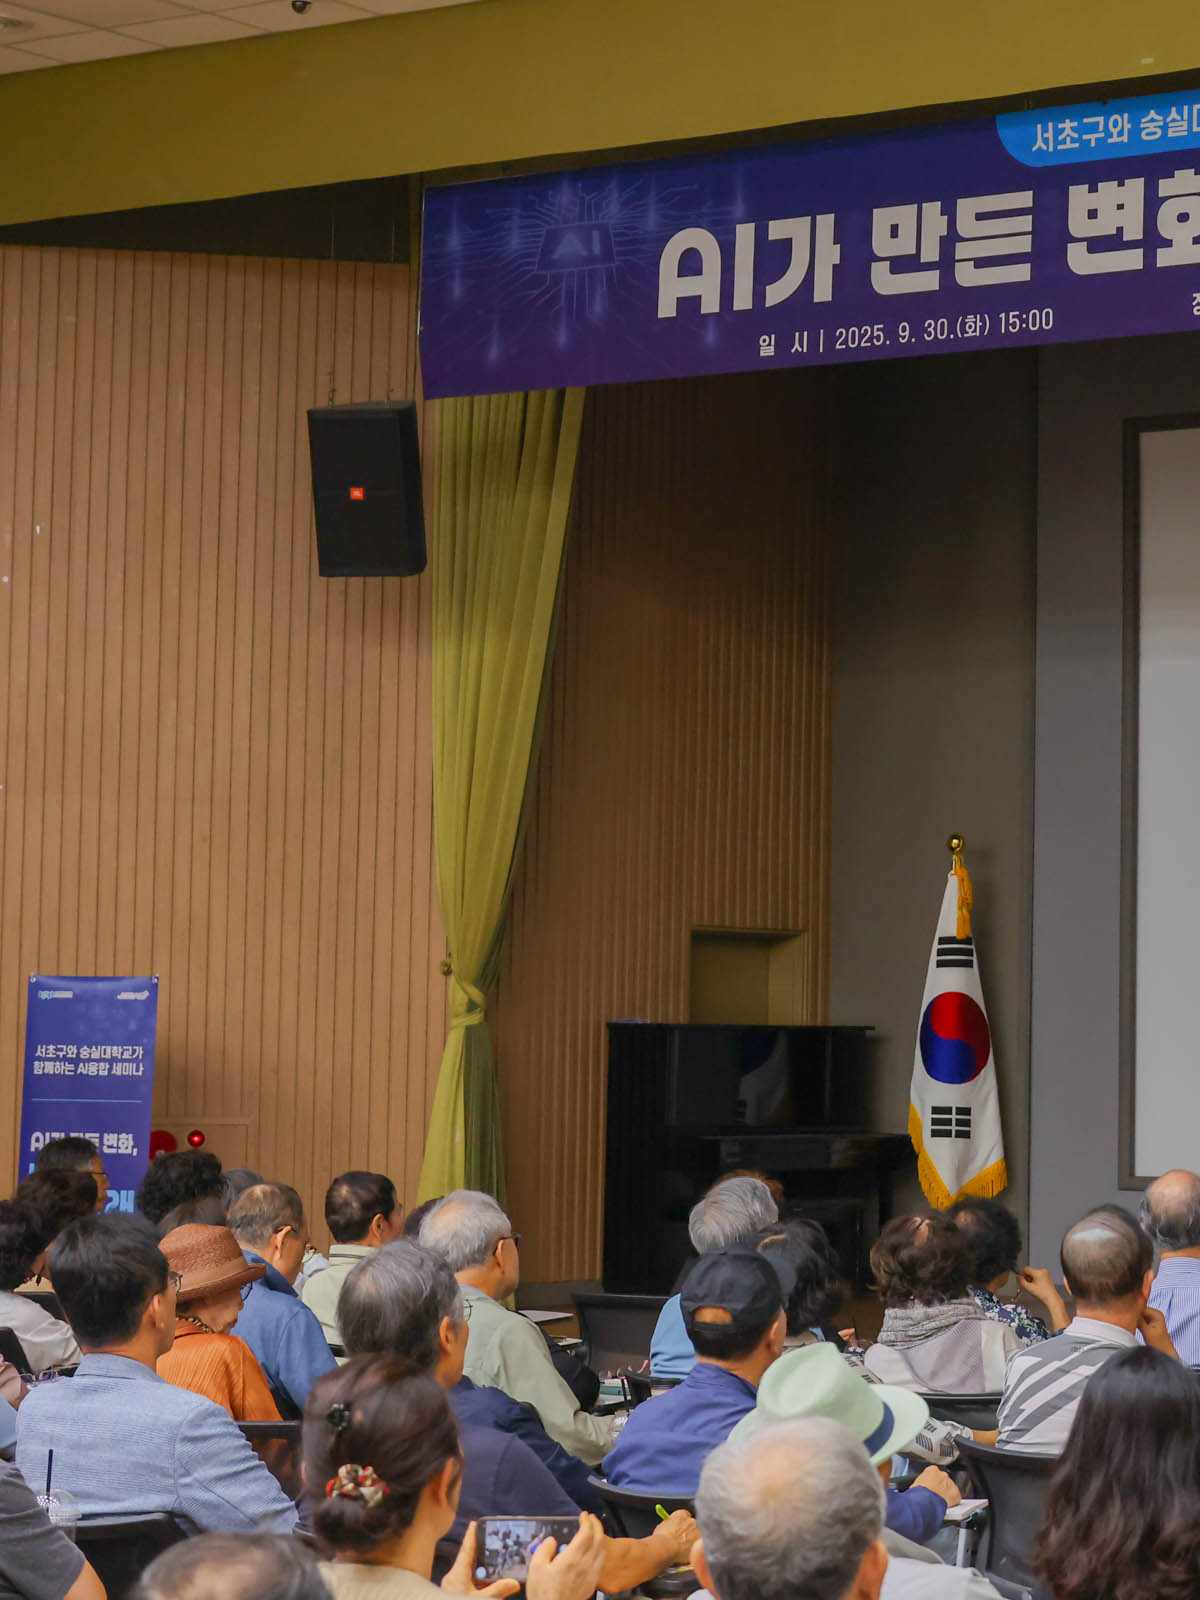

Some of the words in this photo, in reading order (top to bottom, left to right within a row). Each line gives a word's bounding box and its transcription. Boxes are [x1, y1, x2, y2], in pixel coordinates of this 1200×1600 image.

[1031, 111, 1131, 154] 서초구와
[657, 212, 841, 318] AI가
[870, 189, 1034, 296] 만든
[758, 334, 777, 357] 일
[791, 331, 809, 354] 시
[835, 323, 891, 350] 2025.
[898, 321, 916, 345] 9.
[923, 312, 991, 342] 30.(화)
[998, 308, 1054, 334] 15:00
[33, 1060, 75, 1077] 함께하는
[77, 1061, 110, 1077] AI융합
[111, 1062, 144, 1077] 세미나
[35, 1044, 78, 1060] 서초구와
[79, 1044, 144, 1061] 숭실대학교가
[102, 1132, 138, 1157] 변화,
